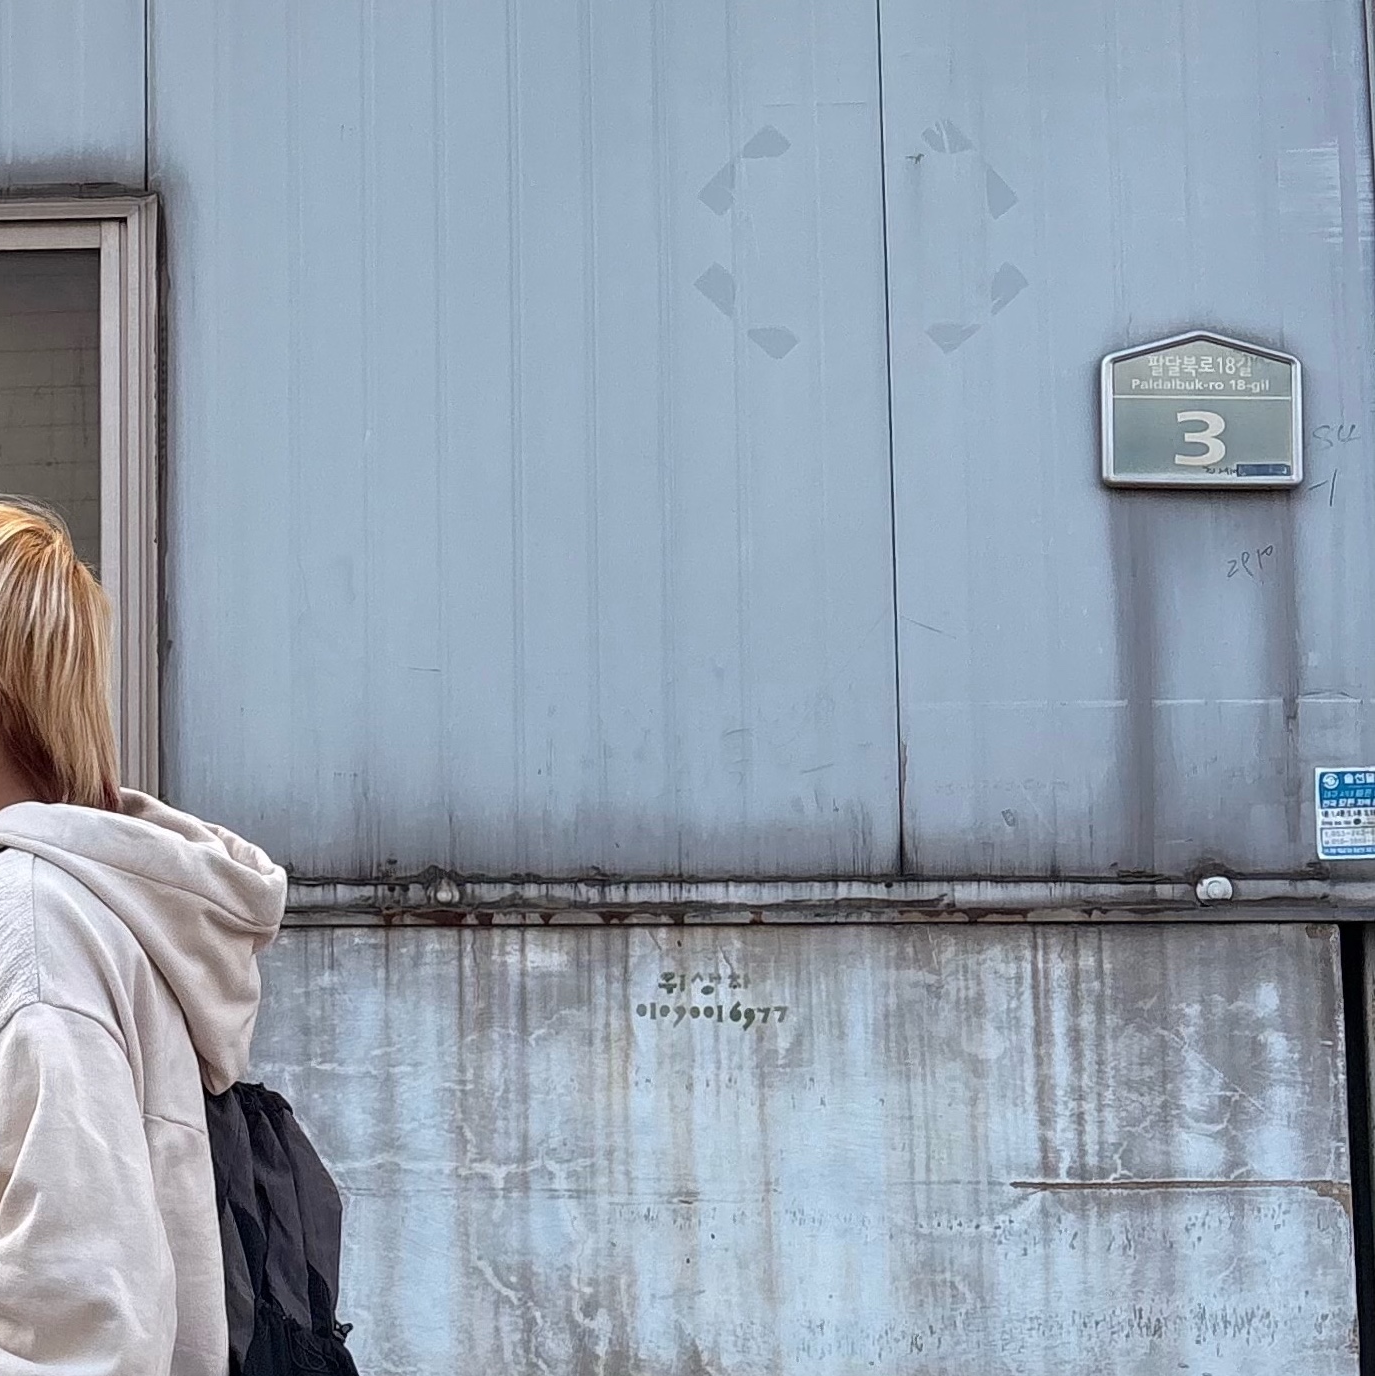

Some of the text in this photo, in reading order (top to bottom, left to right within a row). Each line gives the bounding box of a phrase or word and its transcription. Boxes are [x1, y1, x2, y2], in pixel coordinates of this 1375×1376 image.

[1148, 355, 1252, 377] 팔달북로18길
[1131, 379, 1270, 393] Paldalbuk-ro 18-gil
[1175, 411, 1226, 466] 3
[636, 1001, 789, 1031] 01090016977
